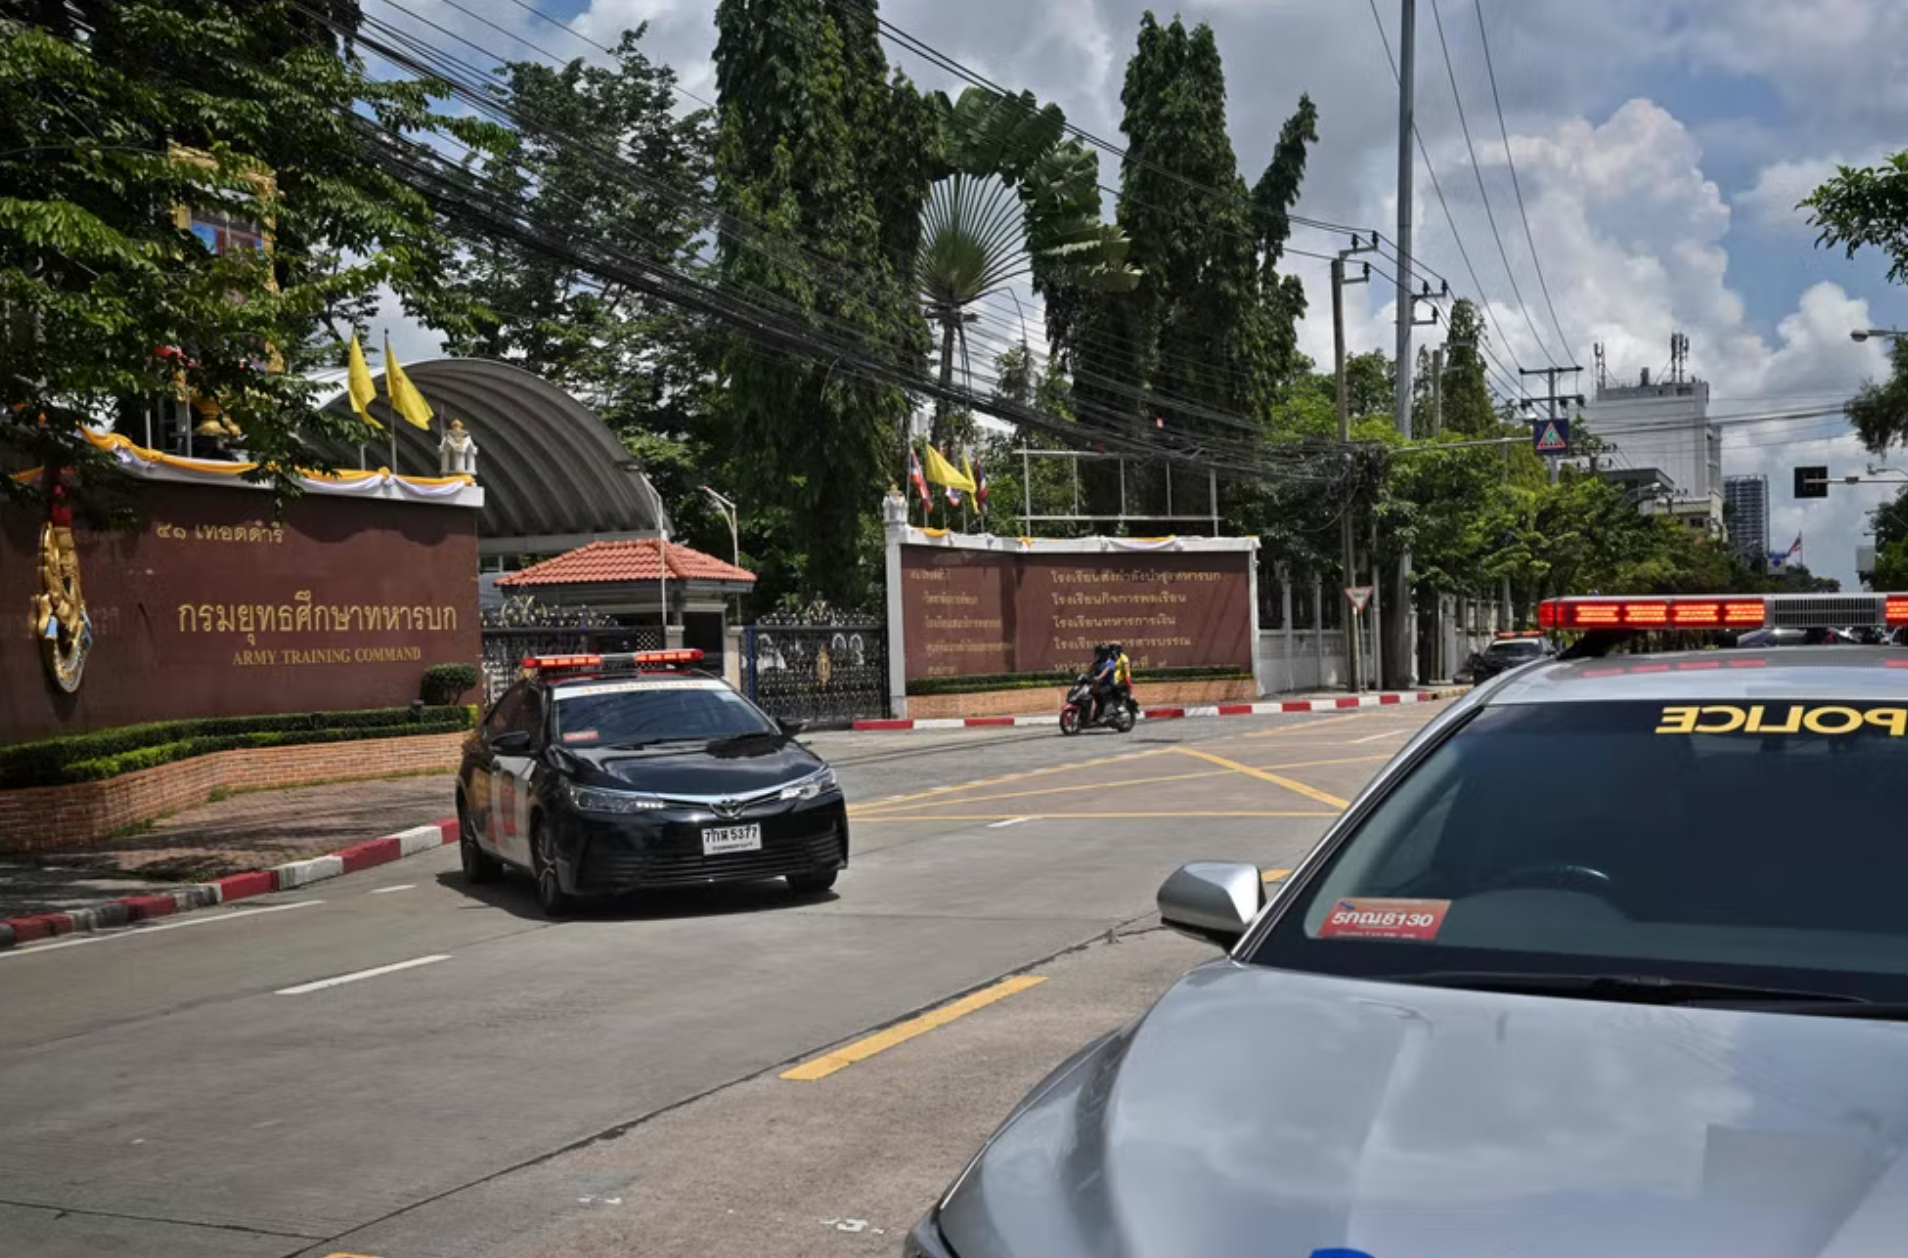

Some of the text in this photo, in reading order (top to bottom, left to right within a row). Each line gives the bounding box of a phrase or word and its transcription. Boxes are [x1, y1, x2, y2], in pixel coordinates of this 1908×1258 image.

[178, 590, 458, 646] กรมยุทธศึกษาทหารบก
[232, 646, 421, 666] ARMY TRAINING COMMAND
[731, 825, 758, 841] 5377
